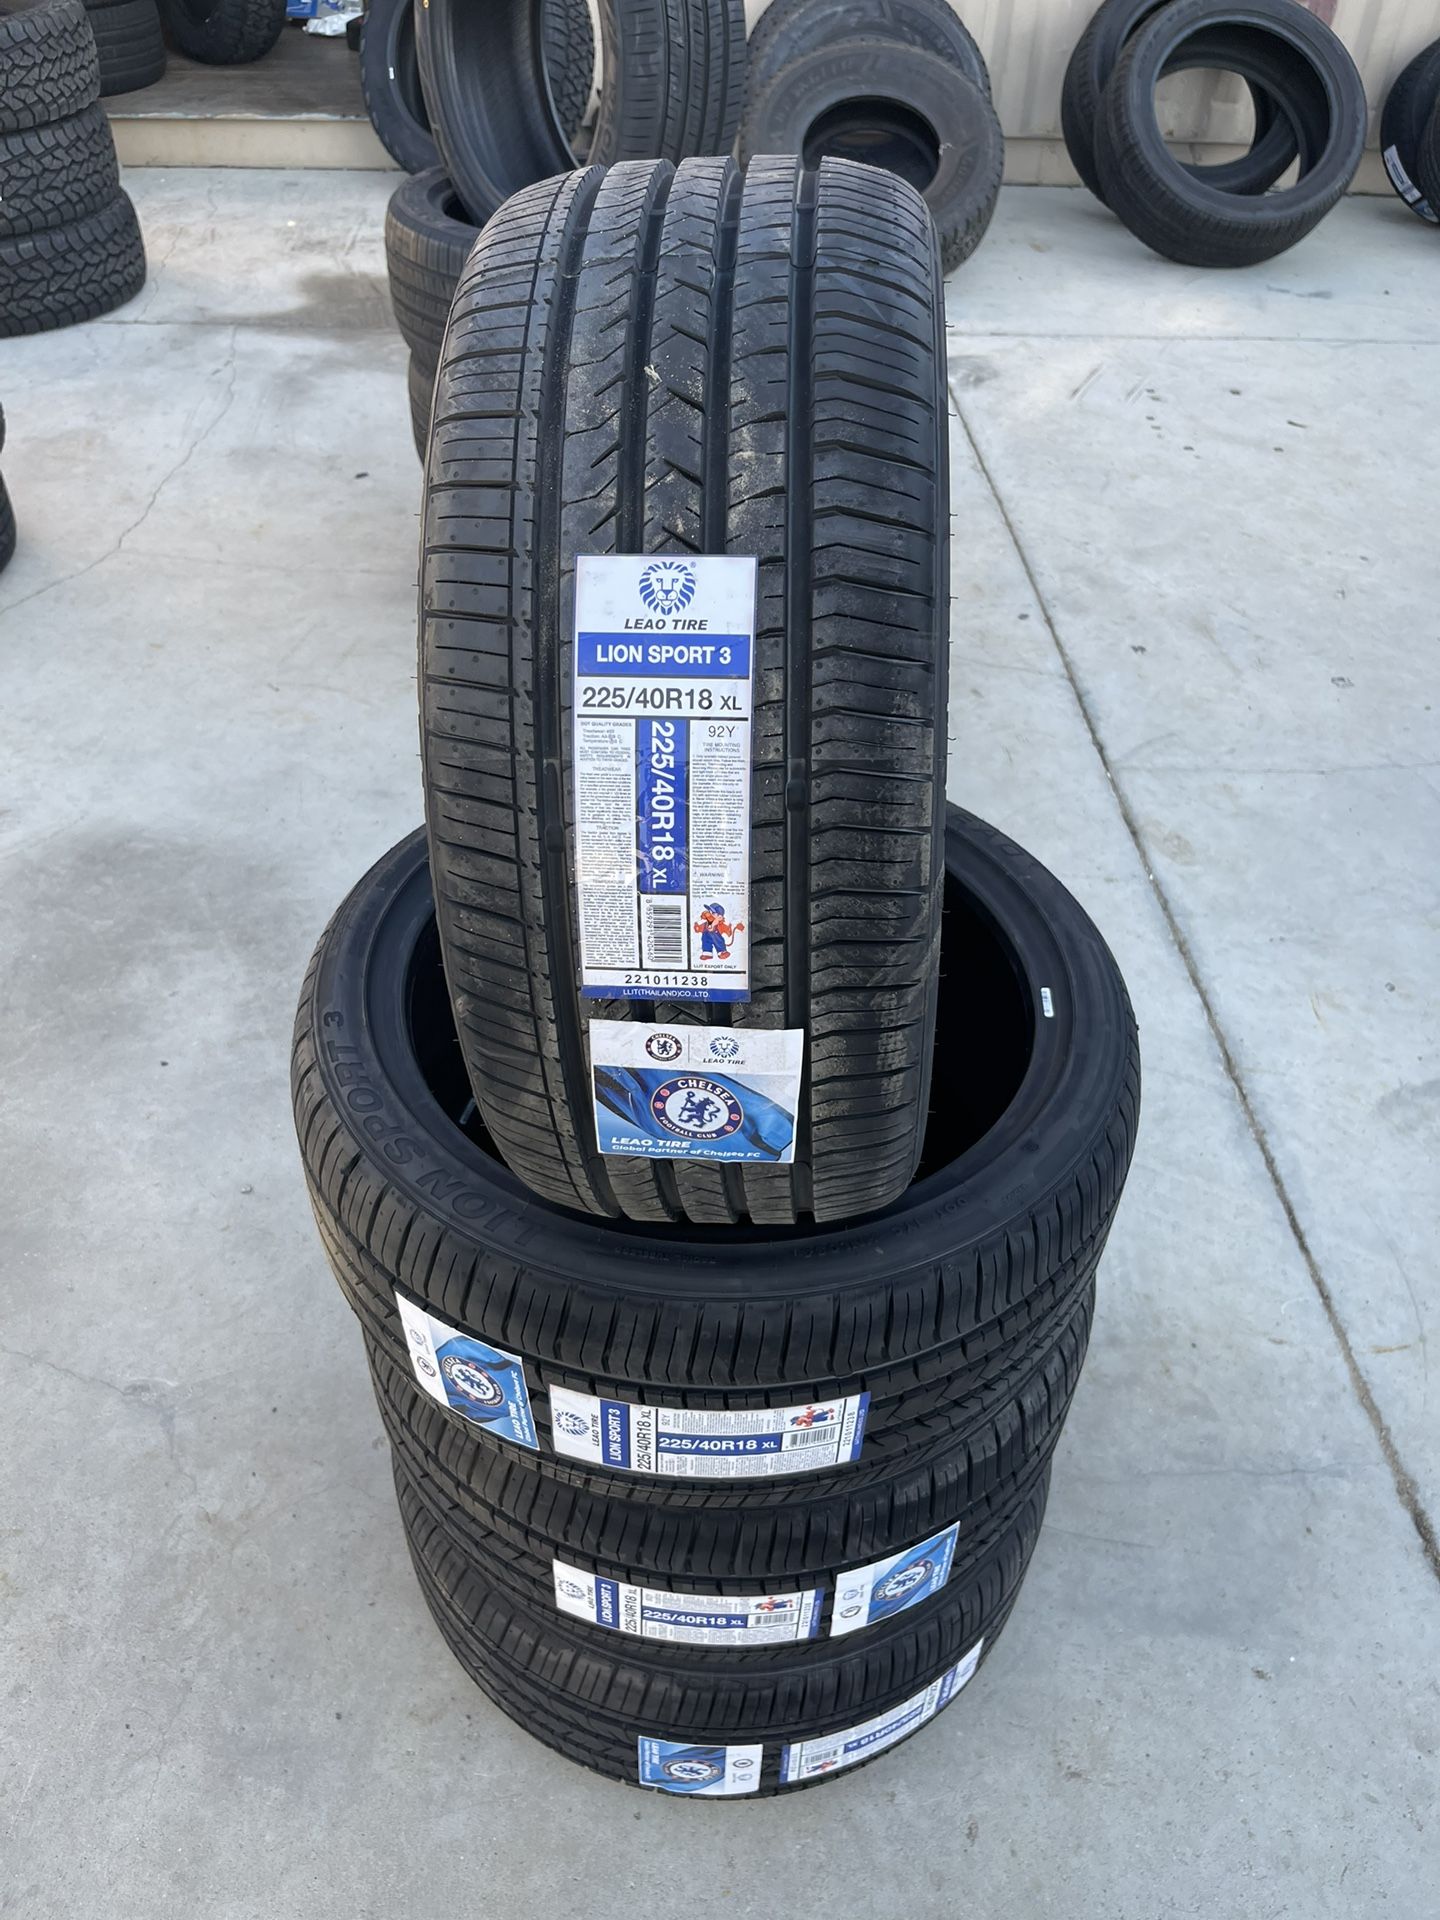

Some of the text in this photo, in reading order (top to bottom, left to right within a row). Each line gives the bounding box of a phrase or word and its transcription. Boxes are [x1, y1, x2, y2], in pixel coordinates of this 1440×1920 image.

[624, 618, 708, 630] LEAO TIRE
[596, 644, 732, 664] LION SPORT 3
[582, 686, 742, 711] 225/40R18 XL
[708, 725, 736, 738] 92Y
[651, 720, 676, 888] 225/40R18 XL
[625, 974, 708, 986] 221011238
[678, 1079, 734, 1106] CHELSEA
[322, 1010, 546, 1247] LION SPORT 3
[659, 1116, 693, 1138] FOOTBALL
[611, 1137, 691, 1148] LEAO TIRE
[591, 1413, 599, 1428] TIRE
[608, 1416, 621, 1442] SPORT
[637, 1409, 651, 1470] 225/40R18 XL
[659, 1437, 777, 1451] 225/40R18 XL
[610, 1442, 622, 1461] LION
[601, 1588, 612, 1608] SPORT
[625, 1595, 637, 1632] 225/40R18
[642, 1610, 727, 1625] 225/40R18
